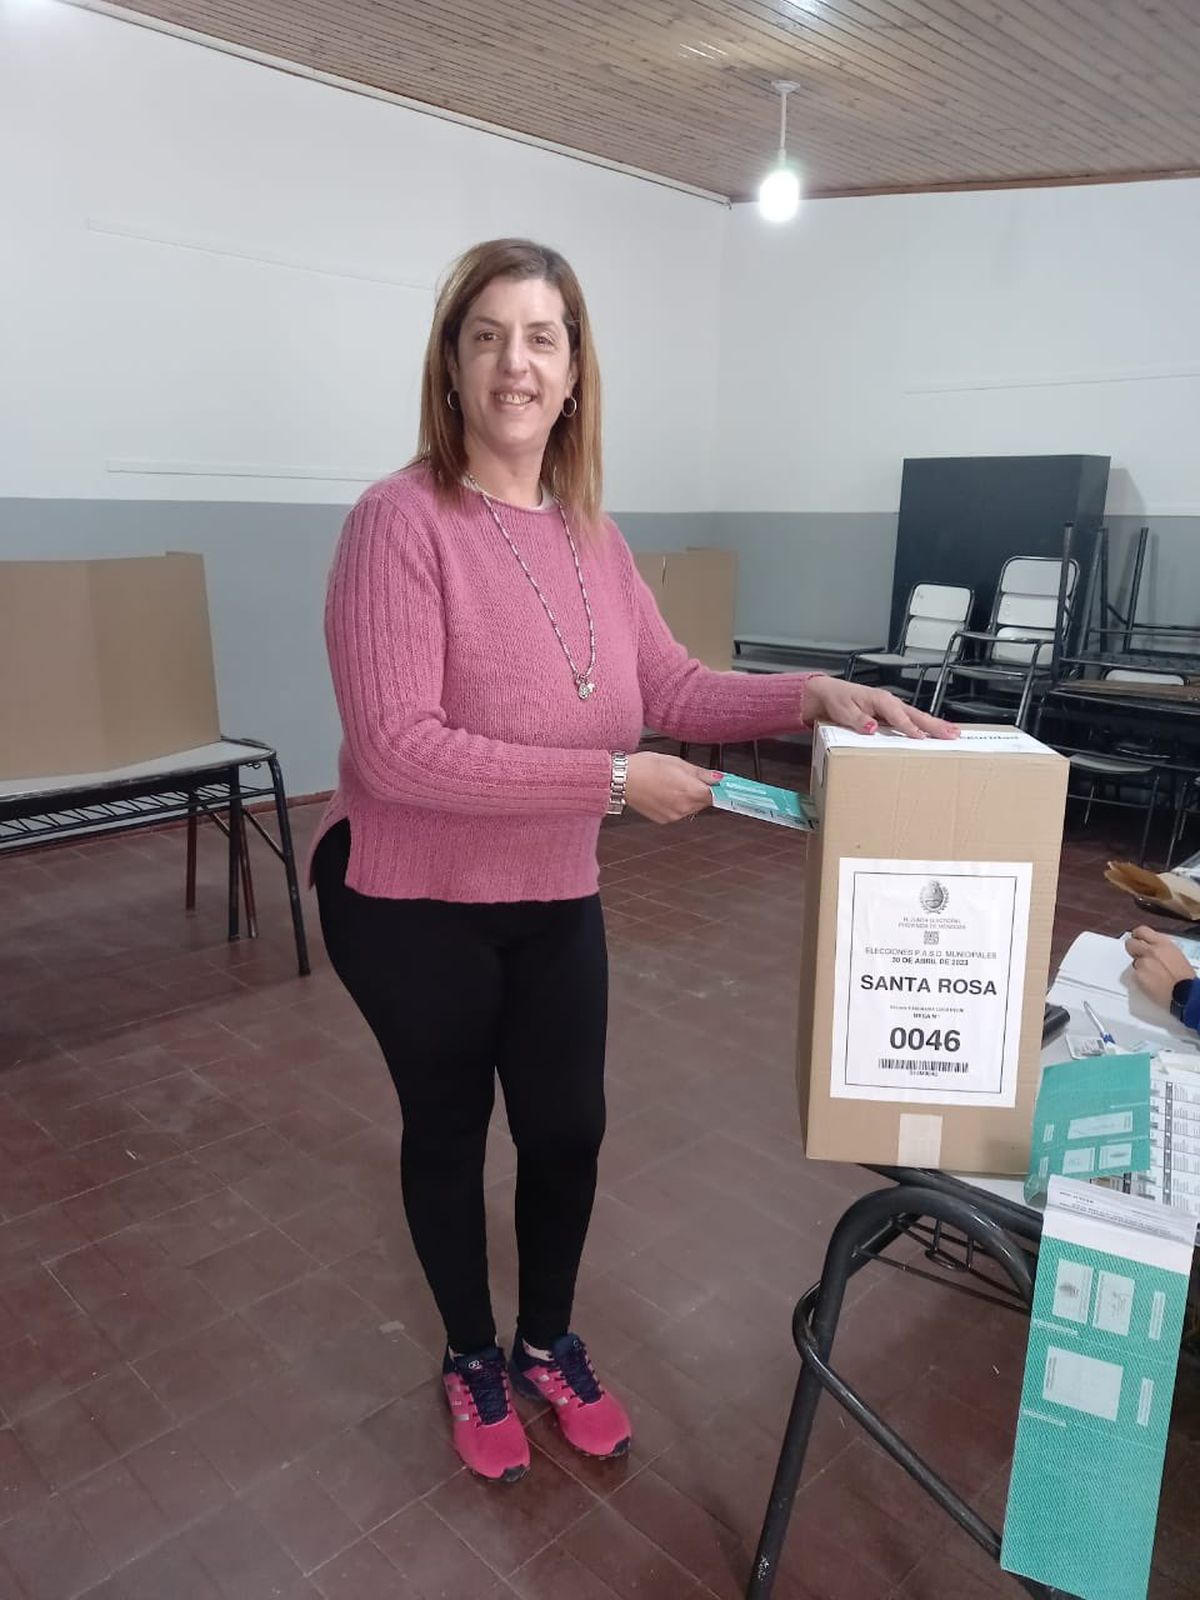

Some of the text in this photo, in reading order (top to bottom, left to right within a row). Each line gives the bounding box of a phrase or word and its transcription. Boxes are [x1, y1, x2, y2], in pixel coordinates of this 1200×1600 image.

[865, 947, 913, 956] ELECCIONES
[945, 950, 997, 960] MUNICIPALES
[860, 975, 997, 995] SANTA ROSA
[889, 1027, 961, 1052] 0046
